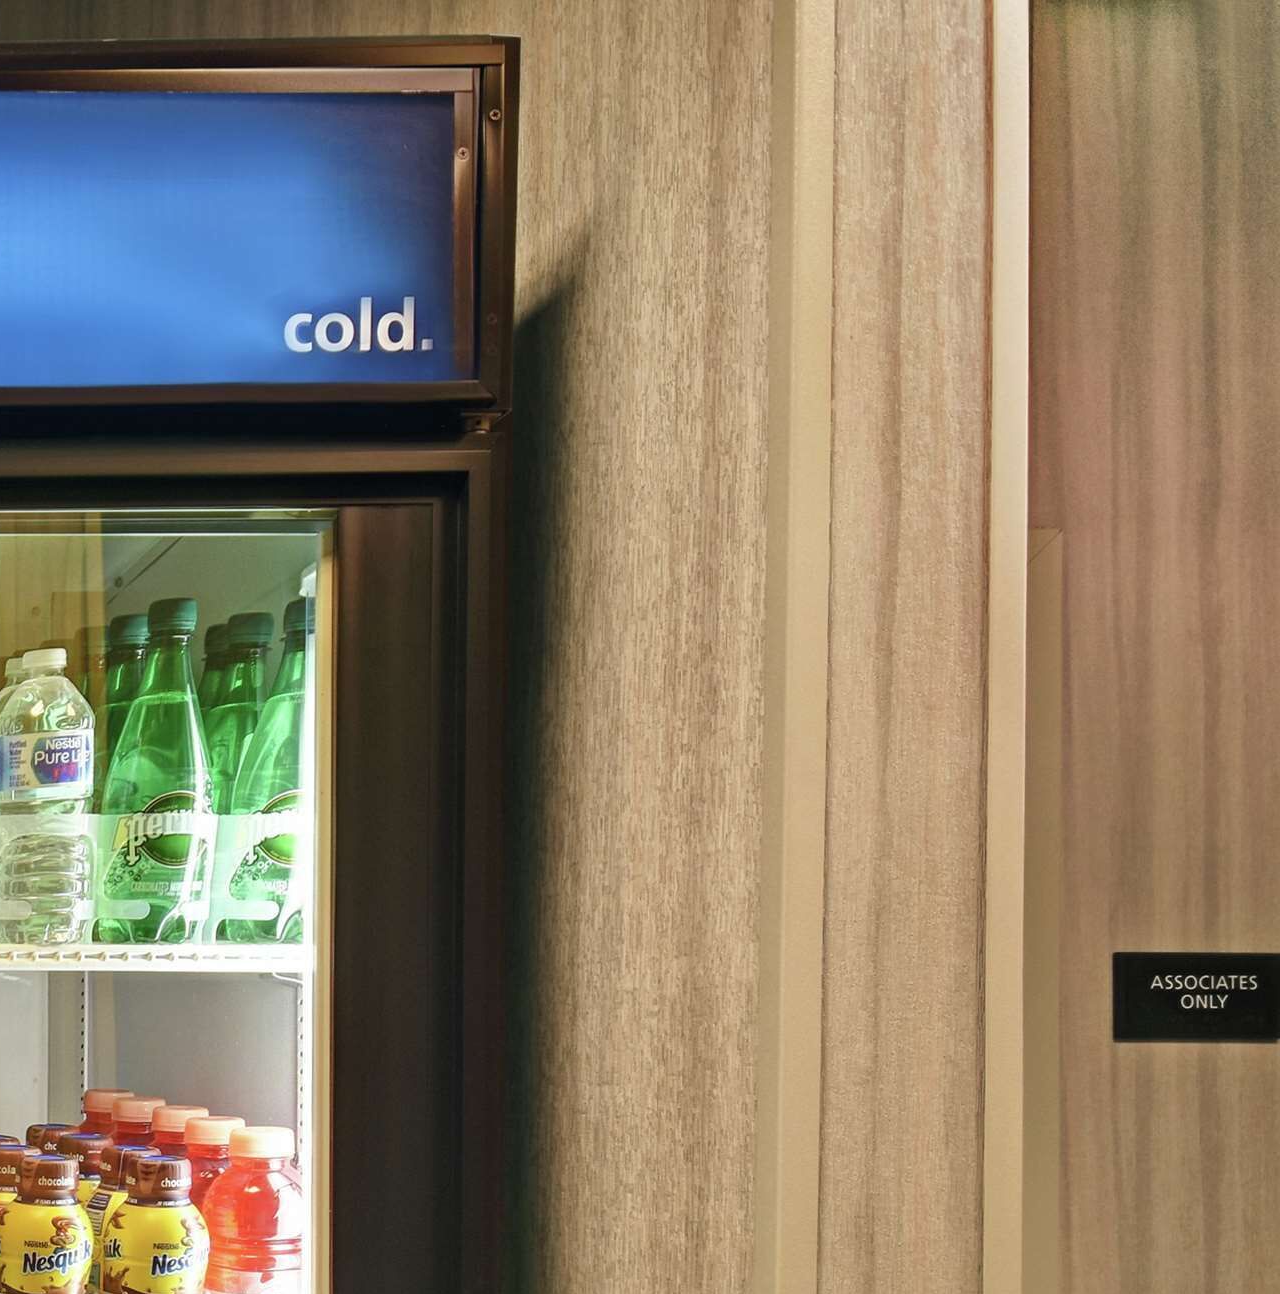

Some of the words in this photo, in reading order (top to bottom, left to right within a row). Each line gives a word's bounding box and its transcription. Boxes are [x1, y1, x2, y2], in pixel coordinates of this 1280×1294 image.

[284, 296, 434, 353] cold.
[34, 751, 70, 765] Pure
[1150, 975, 1259, 990] ASSOCIATES
[1180, 994, 1229, 1009] ONLY
